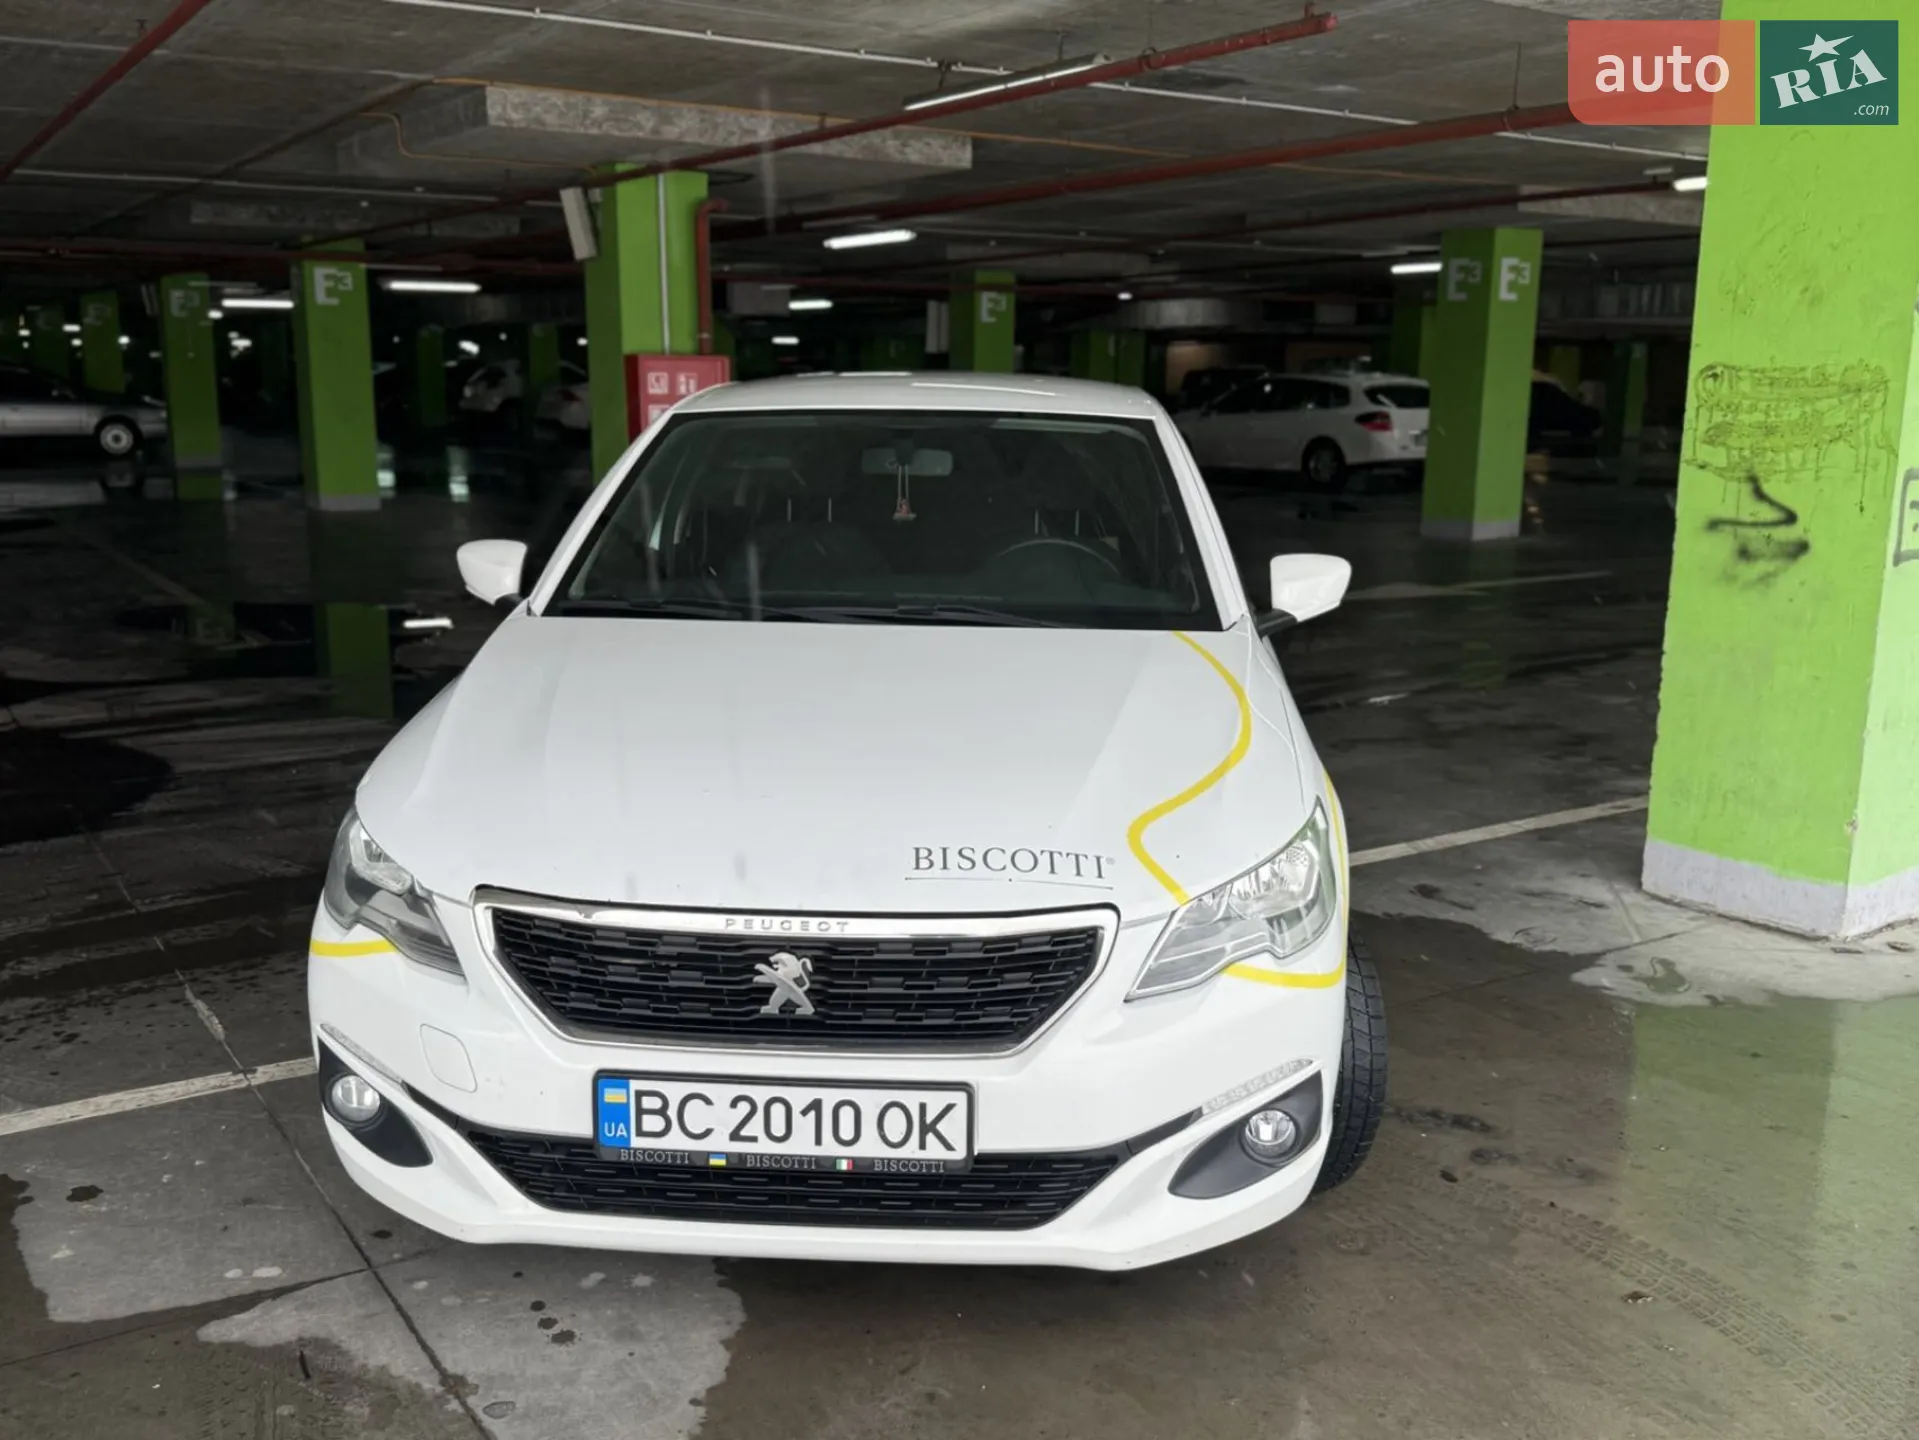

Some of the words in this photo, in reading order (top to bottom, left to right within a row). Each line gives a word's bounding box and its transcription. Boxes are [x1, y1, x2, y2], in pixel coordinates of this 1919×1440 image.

[912, 846, 1106, 880] BISCOTTI
[725, 918, 849, 932] PEUGEOT
[604, 1121, 629, 1138] UA
[633, 1089, 716, 1141] BC
[728, 1094, 863, 1148] 2010
[876, 1100, 958, 1152] OK
[619, 1148, 690, 1165] BISCOTTI
[745, 1154, 817, 1170] BISCOTTI
[873, 1158, 945, 1173] BISCOTTI
